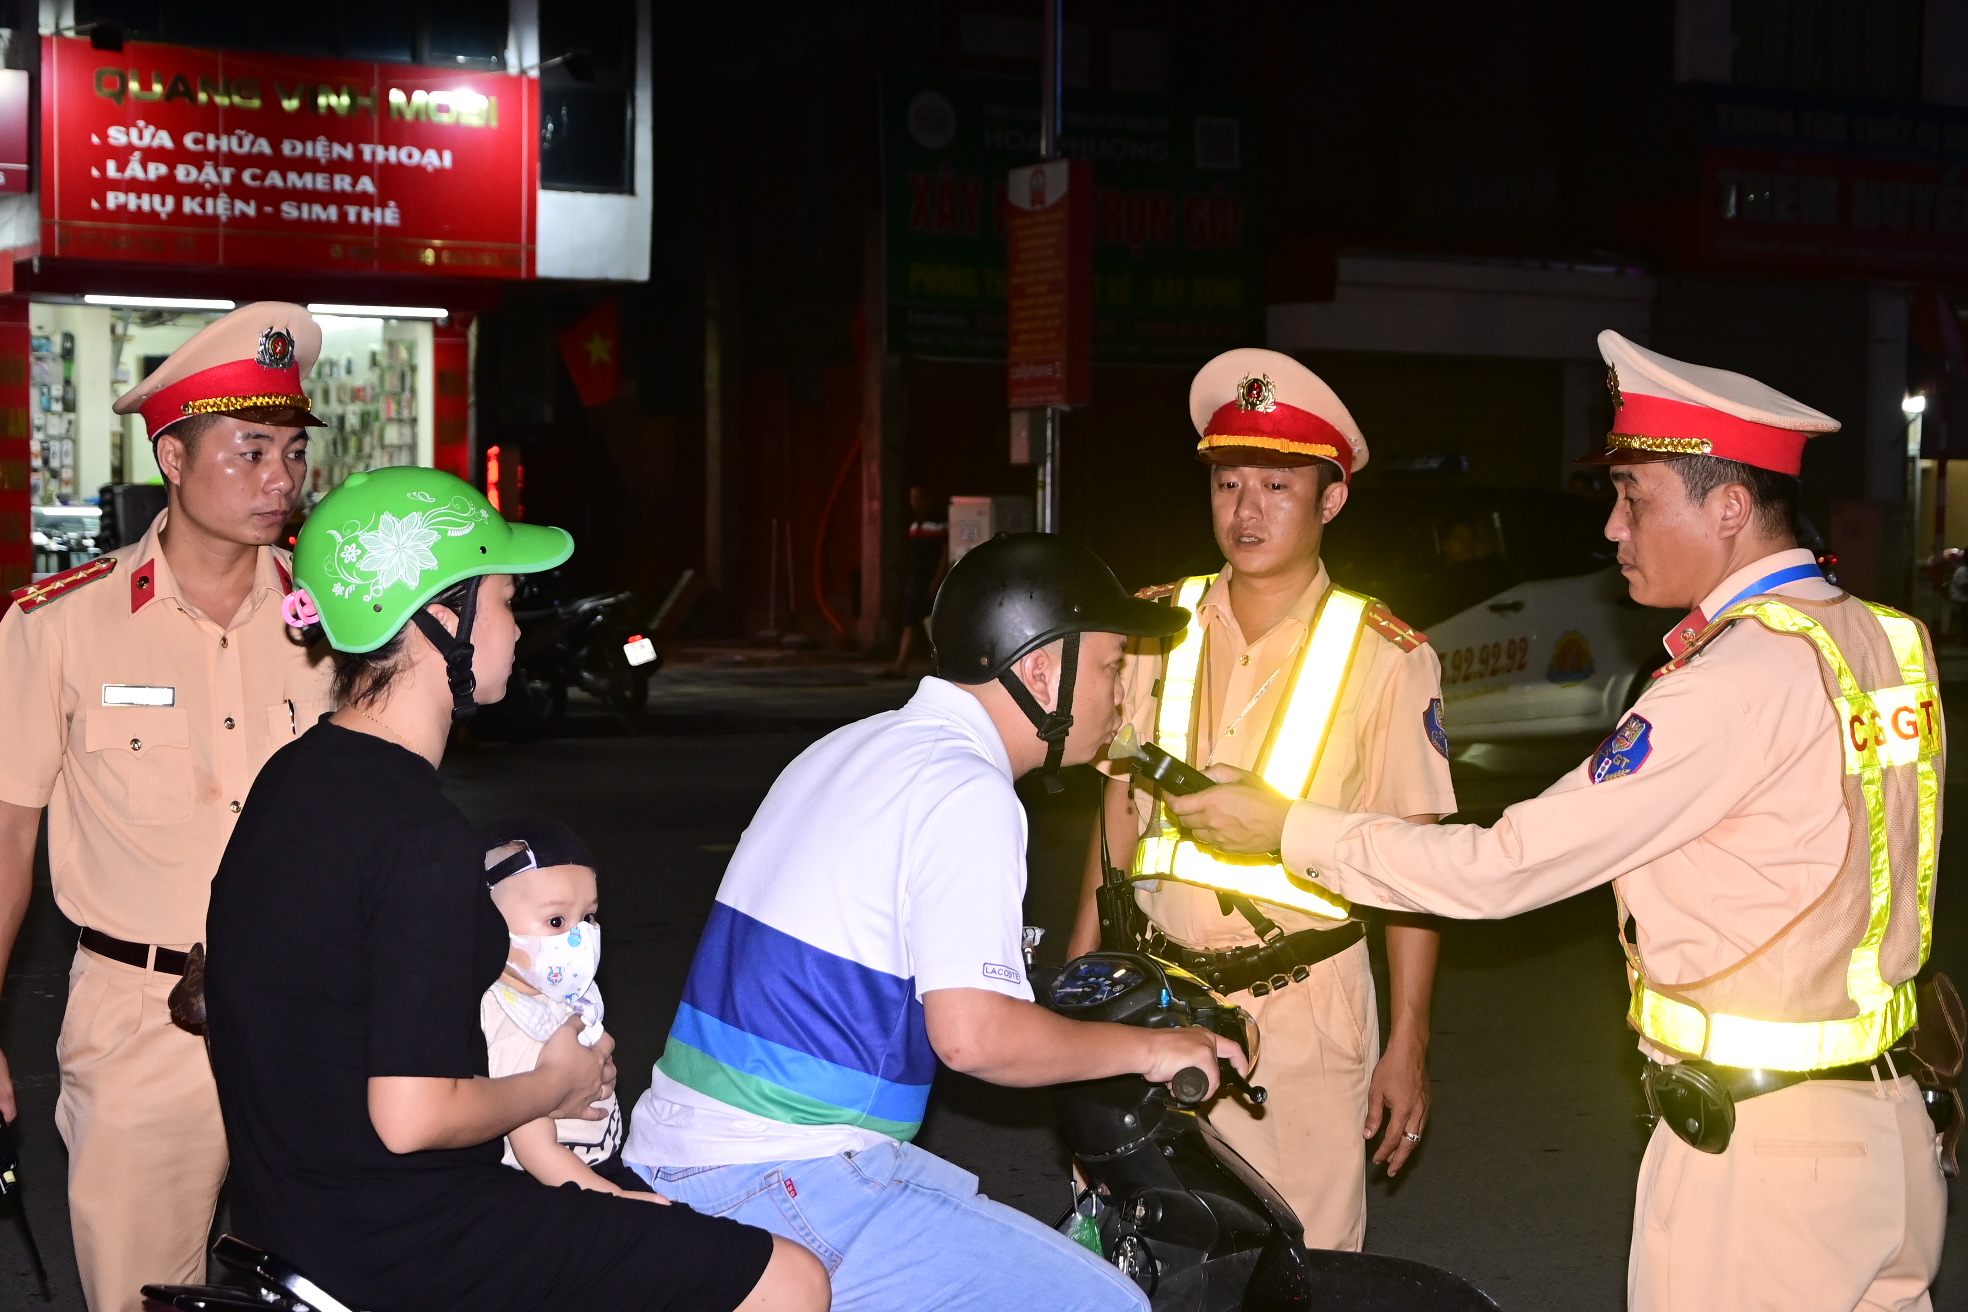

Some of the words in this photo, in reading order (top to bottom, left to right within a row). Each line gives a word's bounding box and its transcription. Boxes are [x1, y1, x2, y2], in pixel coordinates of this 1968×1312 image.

[95, 67, 262, 109] QUANG
[273, 79, 378, 117] VINH
[106, 120, 175, 149] SỬA
[182, 129, 273, 156] CHỮA
[281, 135, 354, 166] ĐIỆN
[358, 143, 453, 173] THOẠI
[106, 151, 169, 181] LẮP
[174, 160, 236, 190] ĐẶT
[241, 167, 377, 195] CAMERA
[106, 190, 175, 220] PHỤ
[182, 192, 257, 223] KIỆN
[280, 200, 339, 223] SIM
[344, 199, 400, 226] THẺ
[908, 162, 983, 236] XÂY
[1091, 187, 1174, 259] RỌN
[1850, 700, 1934, 752] CSGT
[985, 965, 1020, 981] LACOSTE
